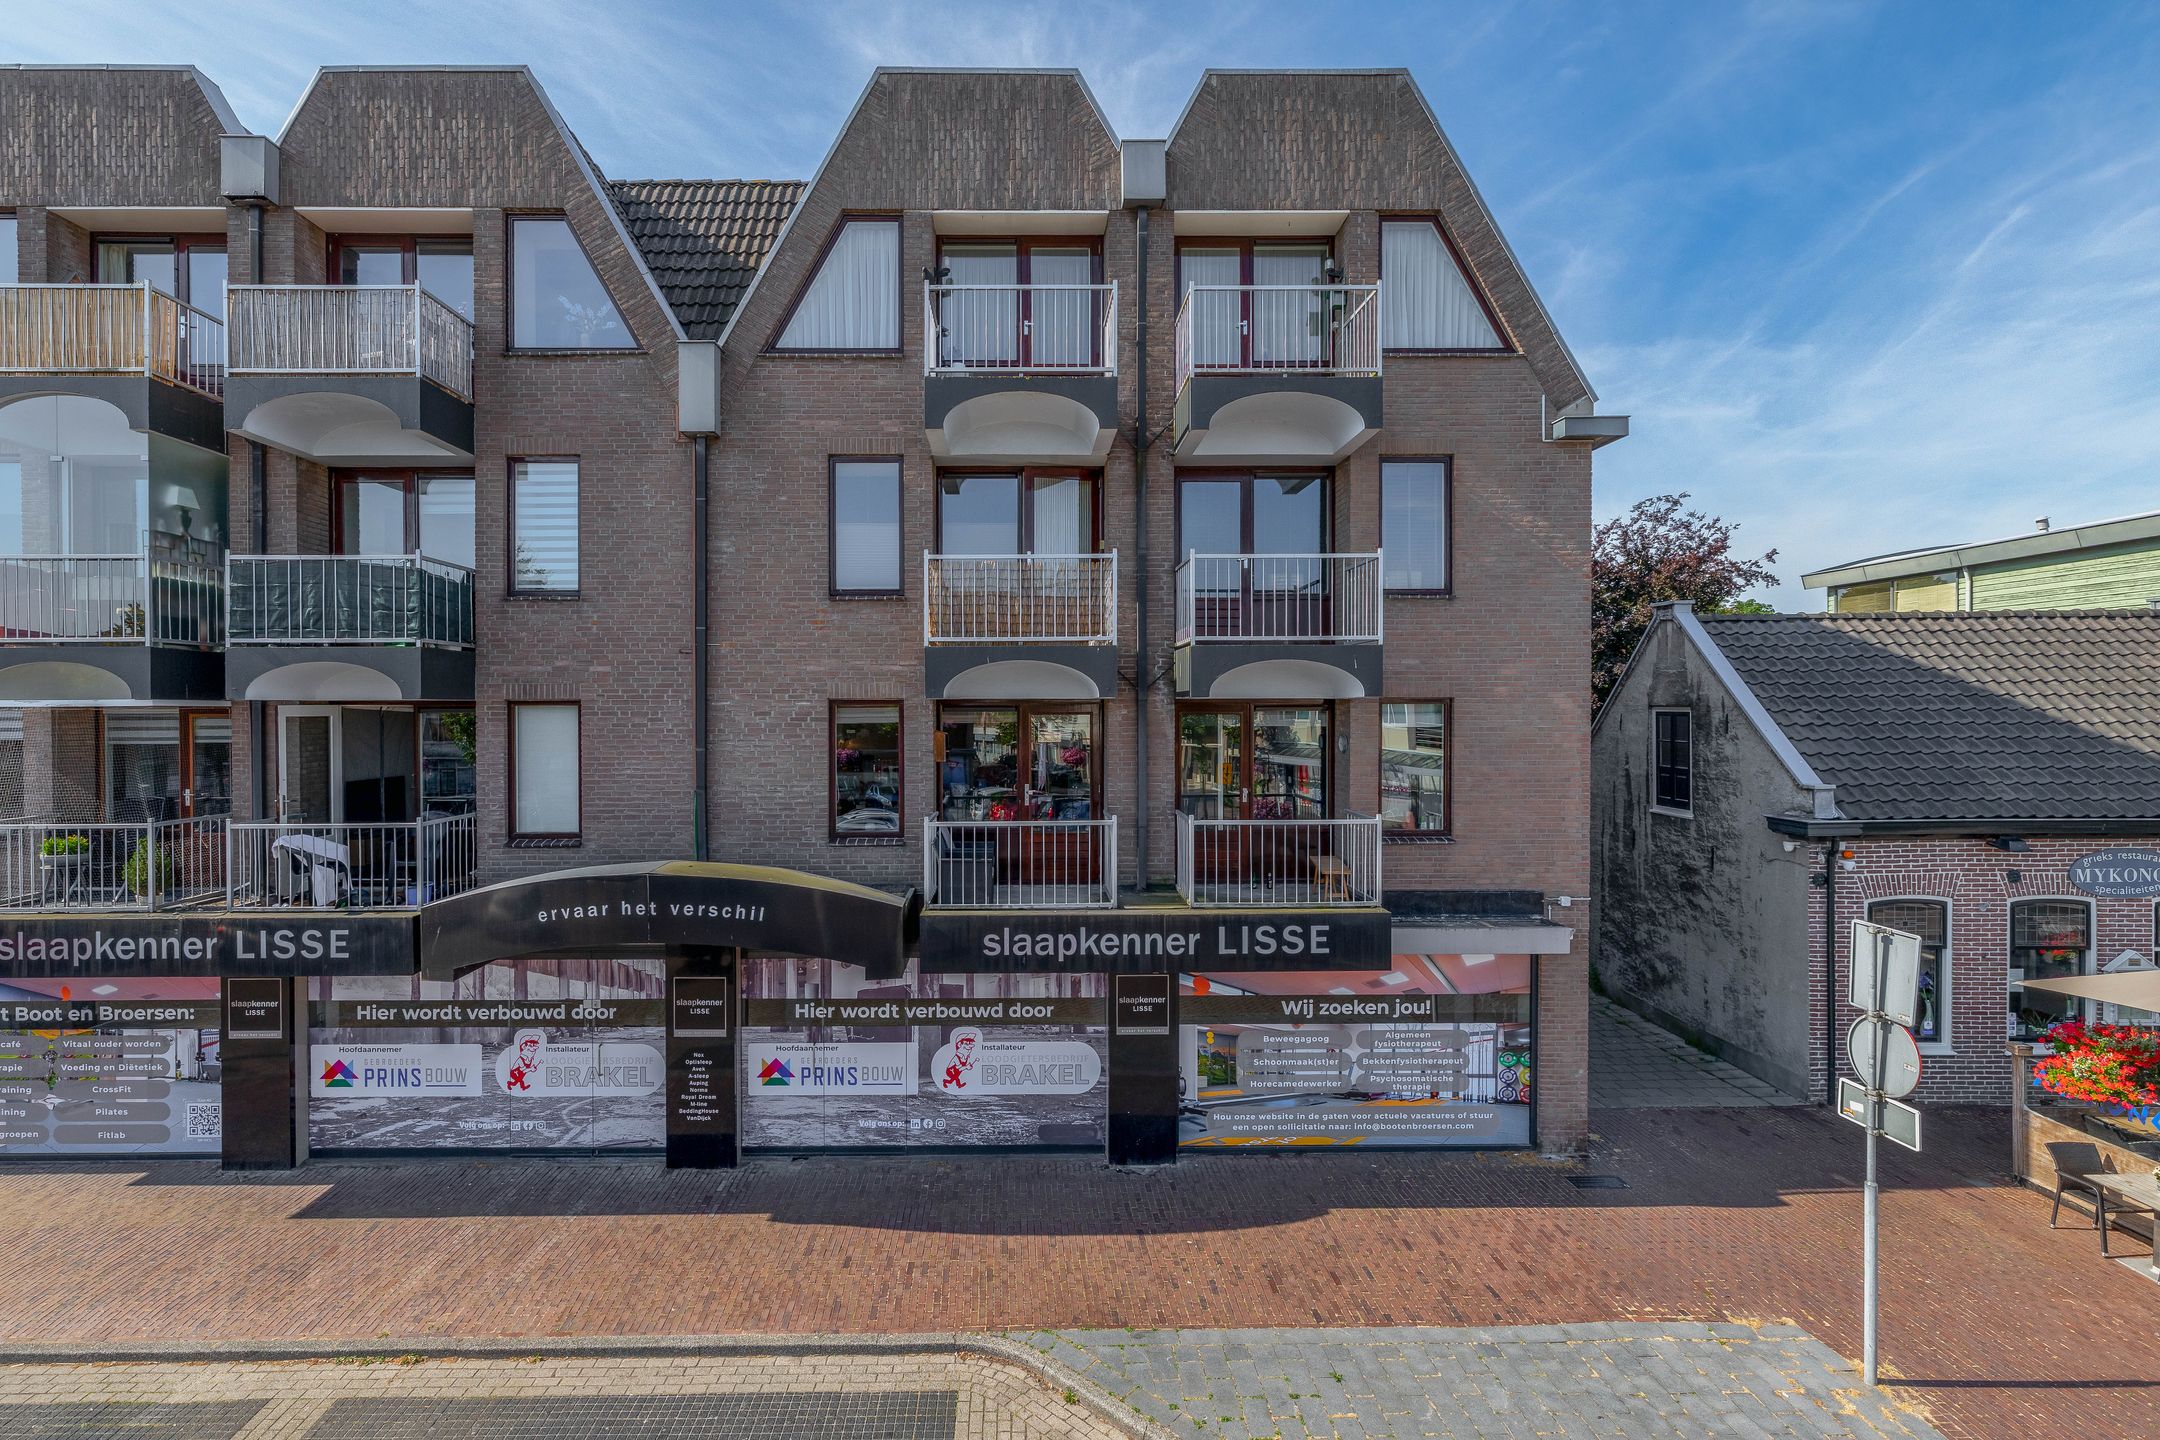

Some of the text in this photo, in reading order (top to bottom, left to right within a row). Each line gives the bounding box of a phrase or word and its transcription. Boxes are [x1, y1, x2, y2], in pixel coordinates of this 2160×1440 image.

[2083, 852, 2160, 867] grieks restaura
[538, 901, 765, 922] ervaar het verschil
[0, 929, 350, 966] slaapkenner LISSE
[982, 925, 1330, 962] slaapkenner LISSE
[231, 1000, 279, 1008] slaapkenner
[676, 999, 723, 1008] slaapkenner
[1119, 996, 1166, 1005] slaapkenner
[356, 1004, 617, 1020] Hier wordt verbouwd door
[795, 1003, 1055, 1019] Hier wordt verbouwd door
[1281, 998, 1431, 1018] Wij zoeken jou!
[15, 1006, 63, 1021] Boot
[68, 1009, 95, 1021] en
[100, 1005, 195, 1021] Broersen:
[1263, 1035, 1330, 1044] Beweegagoog
[1385, 1031, 1431, 1040] Algemeen
[0, 1040, 21, 1048] café
[63, 1040, 161, 1048] Vitaal ouder worden
[1374, 1040, 1442, 1048] fysiotherapeut
[364, 1058, 422, 1066] GEBROEDERS
[1253, 1057, 1339, 1067] Schoonmaak(st)er
[1362, 1057, 1464, 1066] Bekkenfysiotherapeut
[61, 1064, 100, 1072] Voeding
[118, 1063, 163, 1071] Diëtetiek
[364, 1068, 467, 1087] PRINS BOUW
[545, 1066, 655, 1088] BRAKEL
[801, 1066, 904, 1086] PRINS BOUW
[981, 1064, 1090, 1085] BRAKEL
[1370, 1075, 1454, 1083] Psychosomatische
[1250, 1080, 1342, 1088] Horecamedewerker
[1393, 1083, 1431, 1092] therapie
[0, 1086, 32, 1095] aining
[95, 1108, 128, 1116] Pilates
[1322, 1113, 1348, 1121] gaten
[460, 1121, 476, 1129] Volg
[860, 1120, 876, 1128] Volg
[1252, 1124, 1275, 1132] open
[1277, 1122, 1325, 1130] sollicitatie
[1354, 1122, 1474, 1132] info@bootenbroersen.com
[98, 1131, 126, 1139] Fitlab
